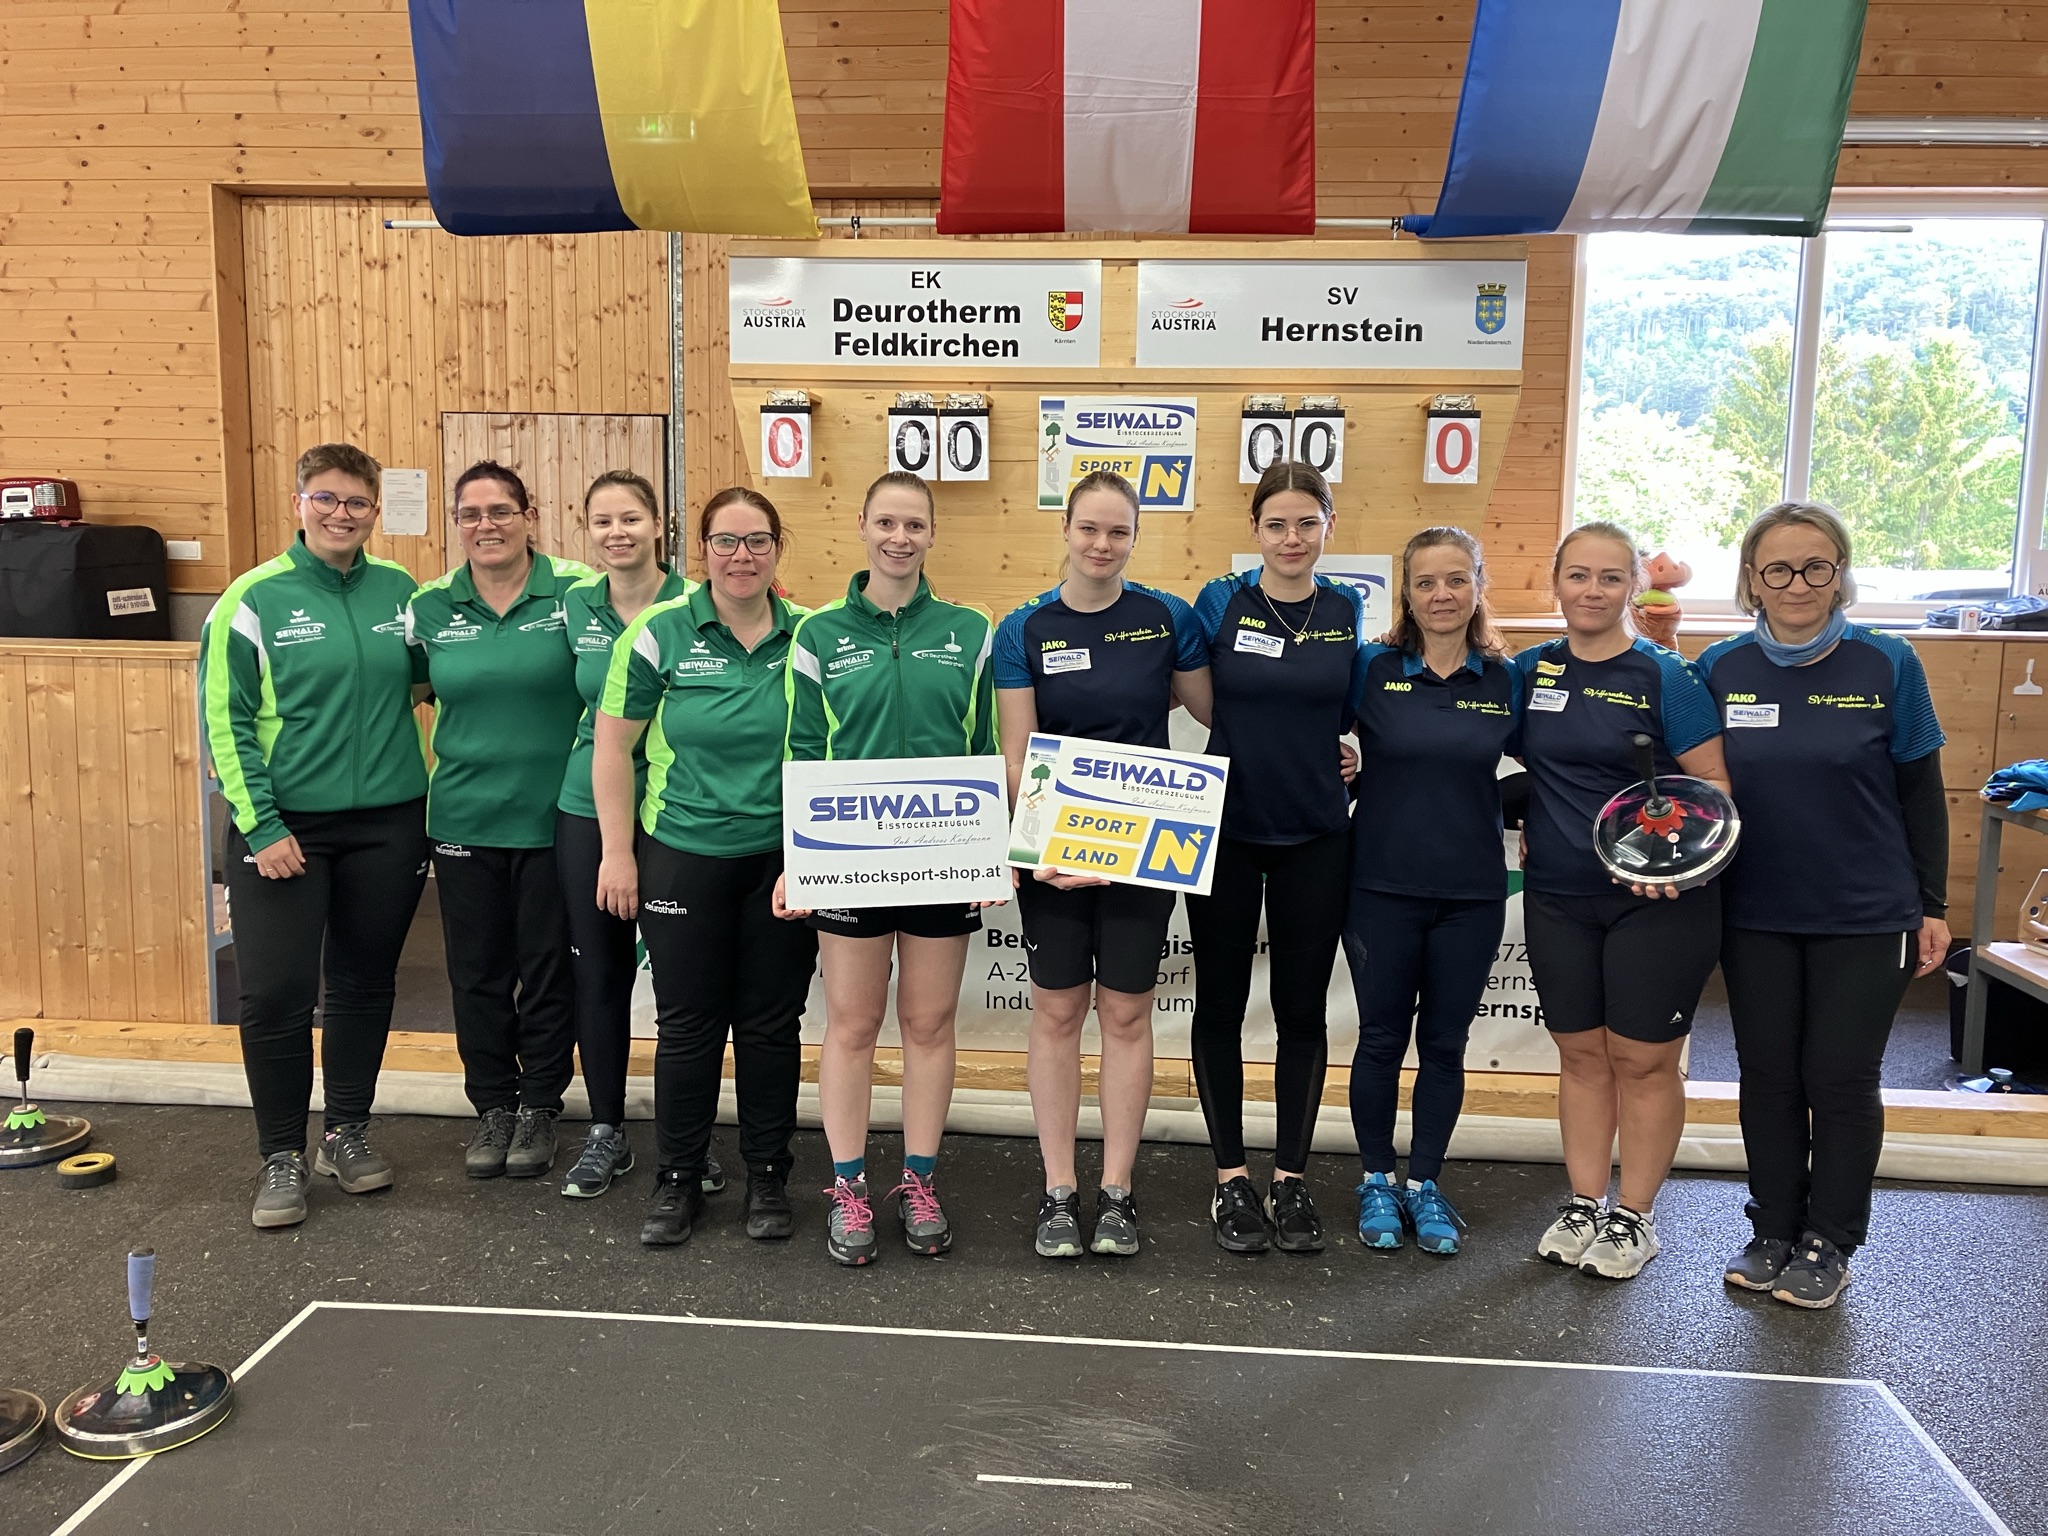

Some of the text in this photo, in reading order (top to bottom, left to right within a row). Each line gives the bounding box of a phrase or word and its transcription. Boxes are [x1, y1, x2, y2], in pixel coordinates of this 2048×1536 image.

[911, 271, 941, 289] EK
[1327, 286, 1359, 305] SV
[742, 308, 806, 317] STOCKSPORT
[833, 298, 1021, 324] Deurotherm
[1151, 311, 1217, 319] STOCKSPORT
[743, 316, 806, 328] AUSTRIA
[1151, 319, 1217, 330] AUSTRIA
[1261, 316, 1423, 342] Hernstein
[834, 332, 1019, 357] Feldkirchen
[1076, 412, 1183, 429] SEIWALD
[1079, 460, 1132, 472] SPORT
[1238, 616, 1267, 629] JAKO
[275, 626, 321, 640] SEIWALD
[437, 628, 477, 639] SEIWALD
[577, 636, 608, 646] SEIWALD
[1041, 640, 1067, 652] JAKO
[1242, 634, 1277, 647] SEIWALD
[678, 660, 723, 670] SEIWALD
[827, 653, 870, 671] SEIWALD
[1048, 654, 1082, 663] SEIWALD
[1383, 681, 1412, 692] JAKO
[1535, 692, 1562, 701] SEIWALD
[1726, 693, 1757, 703] JAKO
[1733, 709, 1770, 717] SEIWALD
[1071, 756, 1208, 792] SEIWALD
[1121, 782, 1205, 801] EISSTOCKERZEUGUNG
[809, 792, 980, 822] SEIWALD
[877, 819, 981, 831] EISSTOCKERZEUGUNG
[1067, 814, 1137, 835] SPORT
[914, 834, 947, 845] Andreas
[949, 833, 992, 845] Kaufmann
[1061, 846, 1119, 866] LAND
[798, 864, 1001, 886] www.stocksport-shop.at
[645, 902, 687, 915] deurotherm
[817, 909, 858, 924] deurotherm
